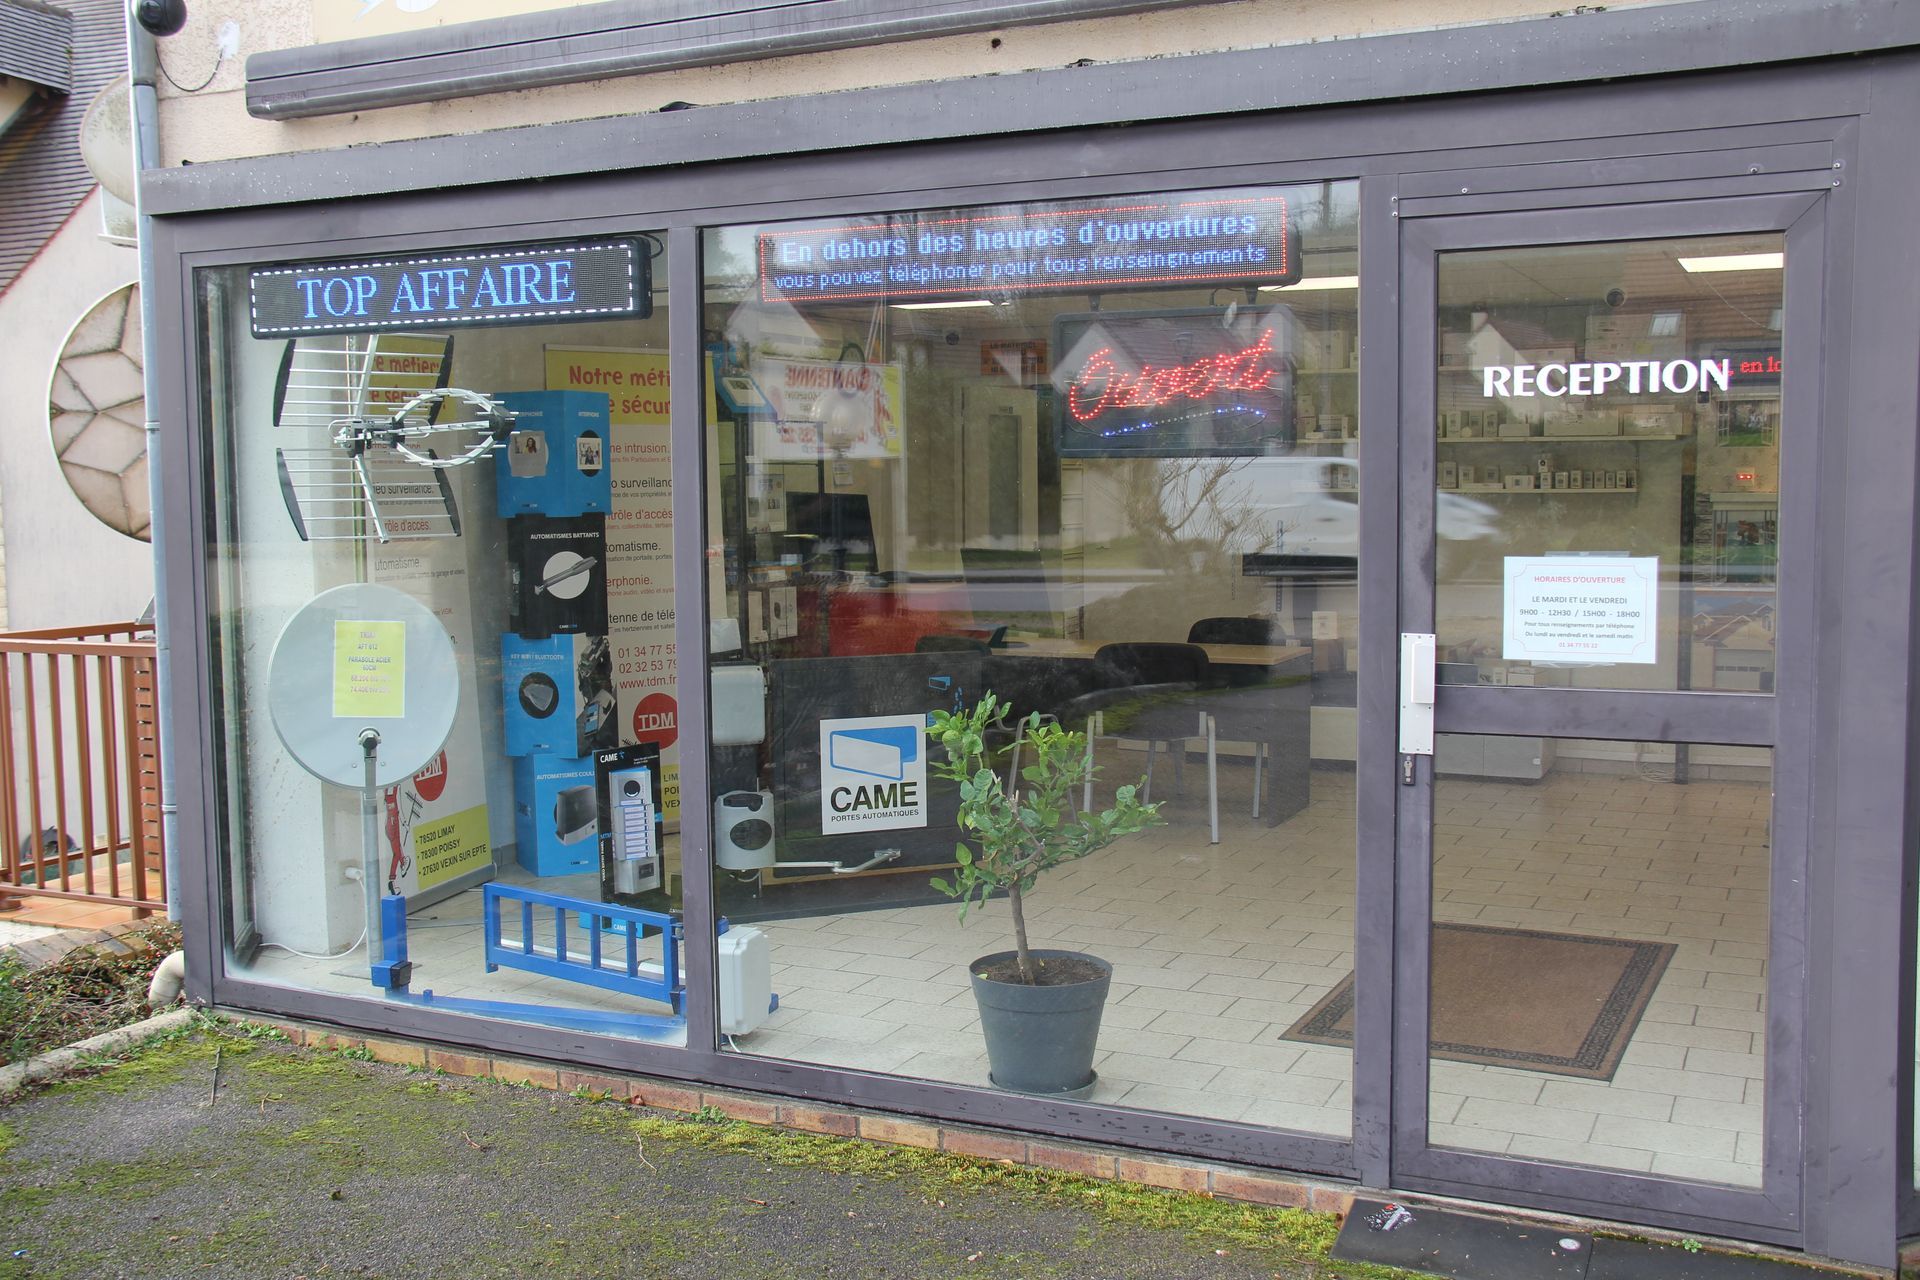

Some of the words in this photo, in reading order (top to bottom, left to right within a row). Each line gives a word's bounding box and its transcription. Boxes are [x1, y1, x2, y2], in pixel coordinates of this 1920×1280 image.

[782, 242, 812, 264] En
[823, 237, 906, 260] dehors
[919, 229, 964, 255] des
[975, 219, 1066, 251] heures
[1079, 214, 1257, 244] d'ouvertures
[774, 272, 815, 289] vous
[820, 269, 884, 290] pouvez
[888, 262, 986, 284] téléphoner
[992, 259, 1037, 279] pour
[1044, 255, 1088, 273] tous
[297, 275, 377, 318] TOP
[391, 260, 575, 313] AFFAIRE
[1740, 361, 1763, 373] en
[569, 366, 623, 385] Notre
[1483, 359, 1729, 397] RECEPTION
[530, 532, 573, 540] AUTOMATISMES
[573, 531, 600, 539] BATTANTS
[1534, 576, 1573, 584] HORAIRES
[1573, 576, 1626, 584] D'OUVERTURE
[1542, 596, 1567, 604] MARDI
[1589, 597, 1628, 605] VENDREDI
[641, 610, 654, 621] de
[1548, 609, 1572, 617] 12H30
[1575, 609, 1579, 617] /
[1583, 610, 1606, 618] 15H00
[1551, 622, 1595, 630] renseignements
[1606, 623, 1635, 631] téléphone
[618, 648, 630, 659] 01
[634, 646, 646, 657] 34
[650, 645, 663, 656] 77
[619, 663, 632, 674] 02
[635, 661, 647, 673] 32
[651, 660, 663, 672] 53
[638, 712, 674, 730] TDM
[600, 752, 618, 764] CAME
[830, 781, 918, 813] CAME
[831, 814, 861, 822] PORTES
[862, 809, 919, 820] AUTOMATIQUES
[420, 833, 437, 845] 78520
[437, 825, 456, 840] LIMAY
[421, 848, 438, 861] 78300
[438, 838, 461, 855] POISSY
[422, 864, 440, 877] 27630
[440, 856, 458, 869] VEXIN
[459, 851, 472, 863] SUR
[472, 844, 487, 857] EPTE
